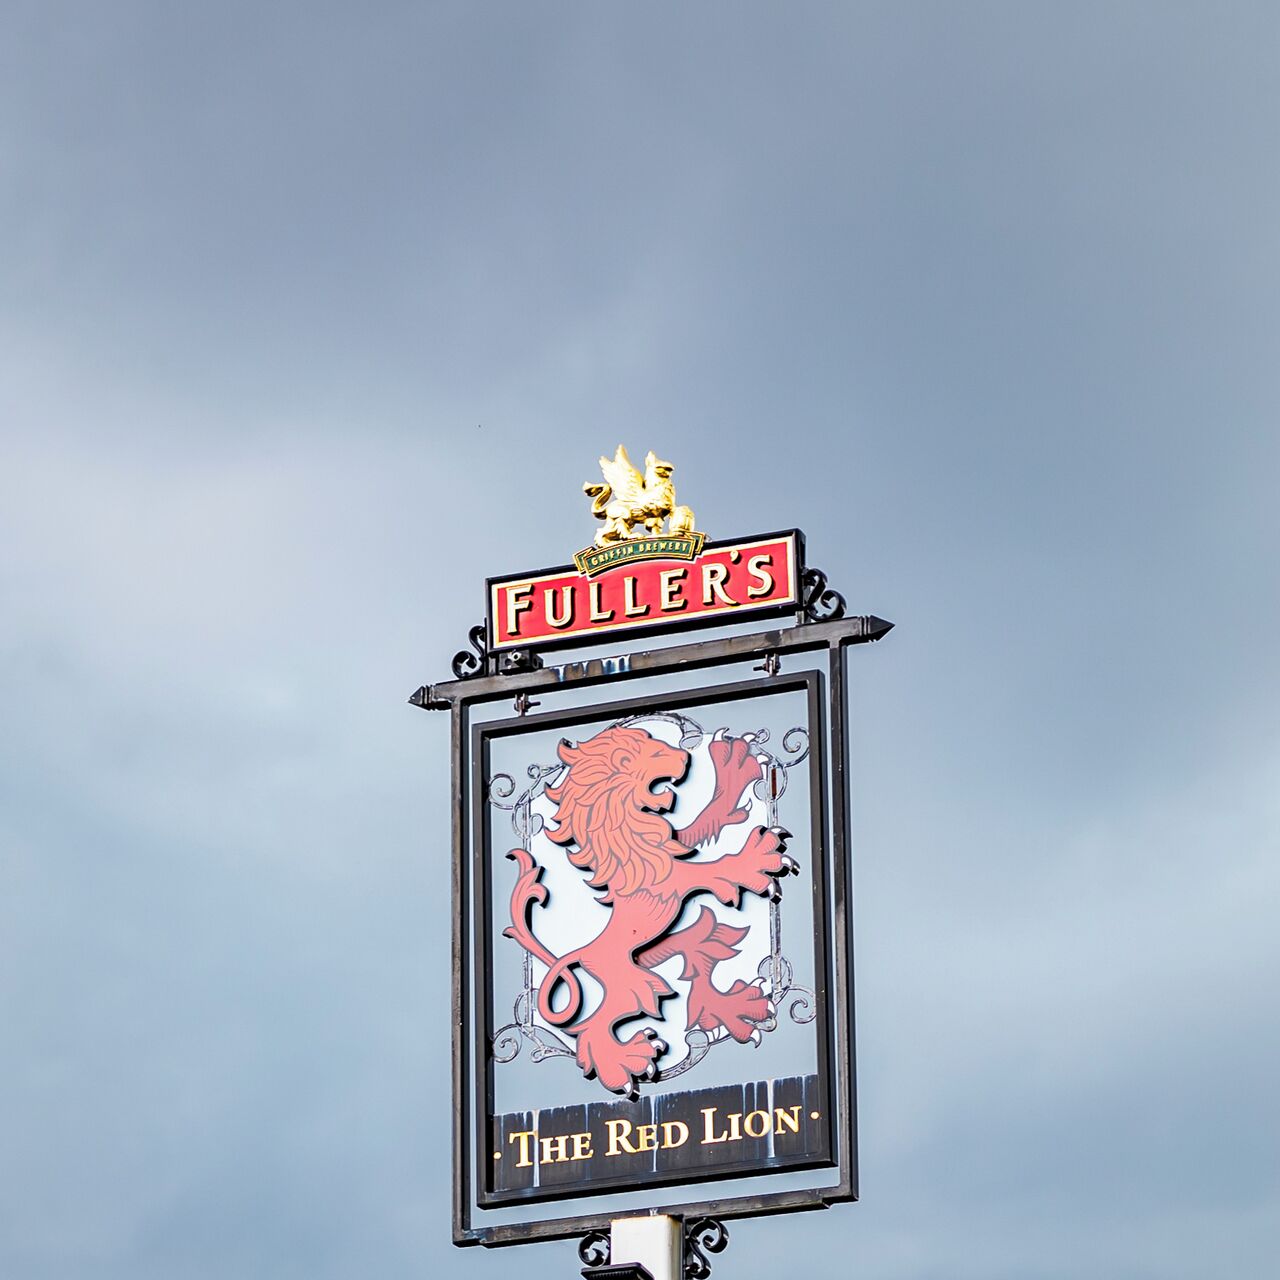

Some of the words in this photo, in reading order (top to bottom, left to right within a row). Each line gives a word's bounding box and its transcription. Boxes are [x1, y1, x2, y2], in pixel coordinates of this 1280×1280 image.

[638, 541, 688, 553] BREWERY
[509, 1130, 594, 1168] THE
[605, 1118, 689, 1157] RED
[700, 1105, 803, 1145] LION
